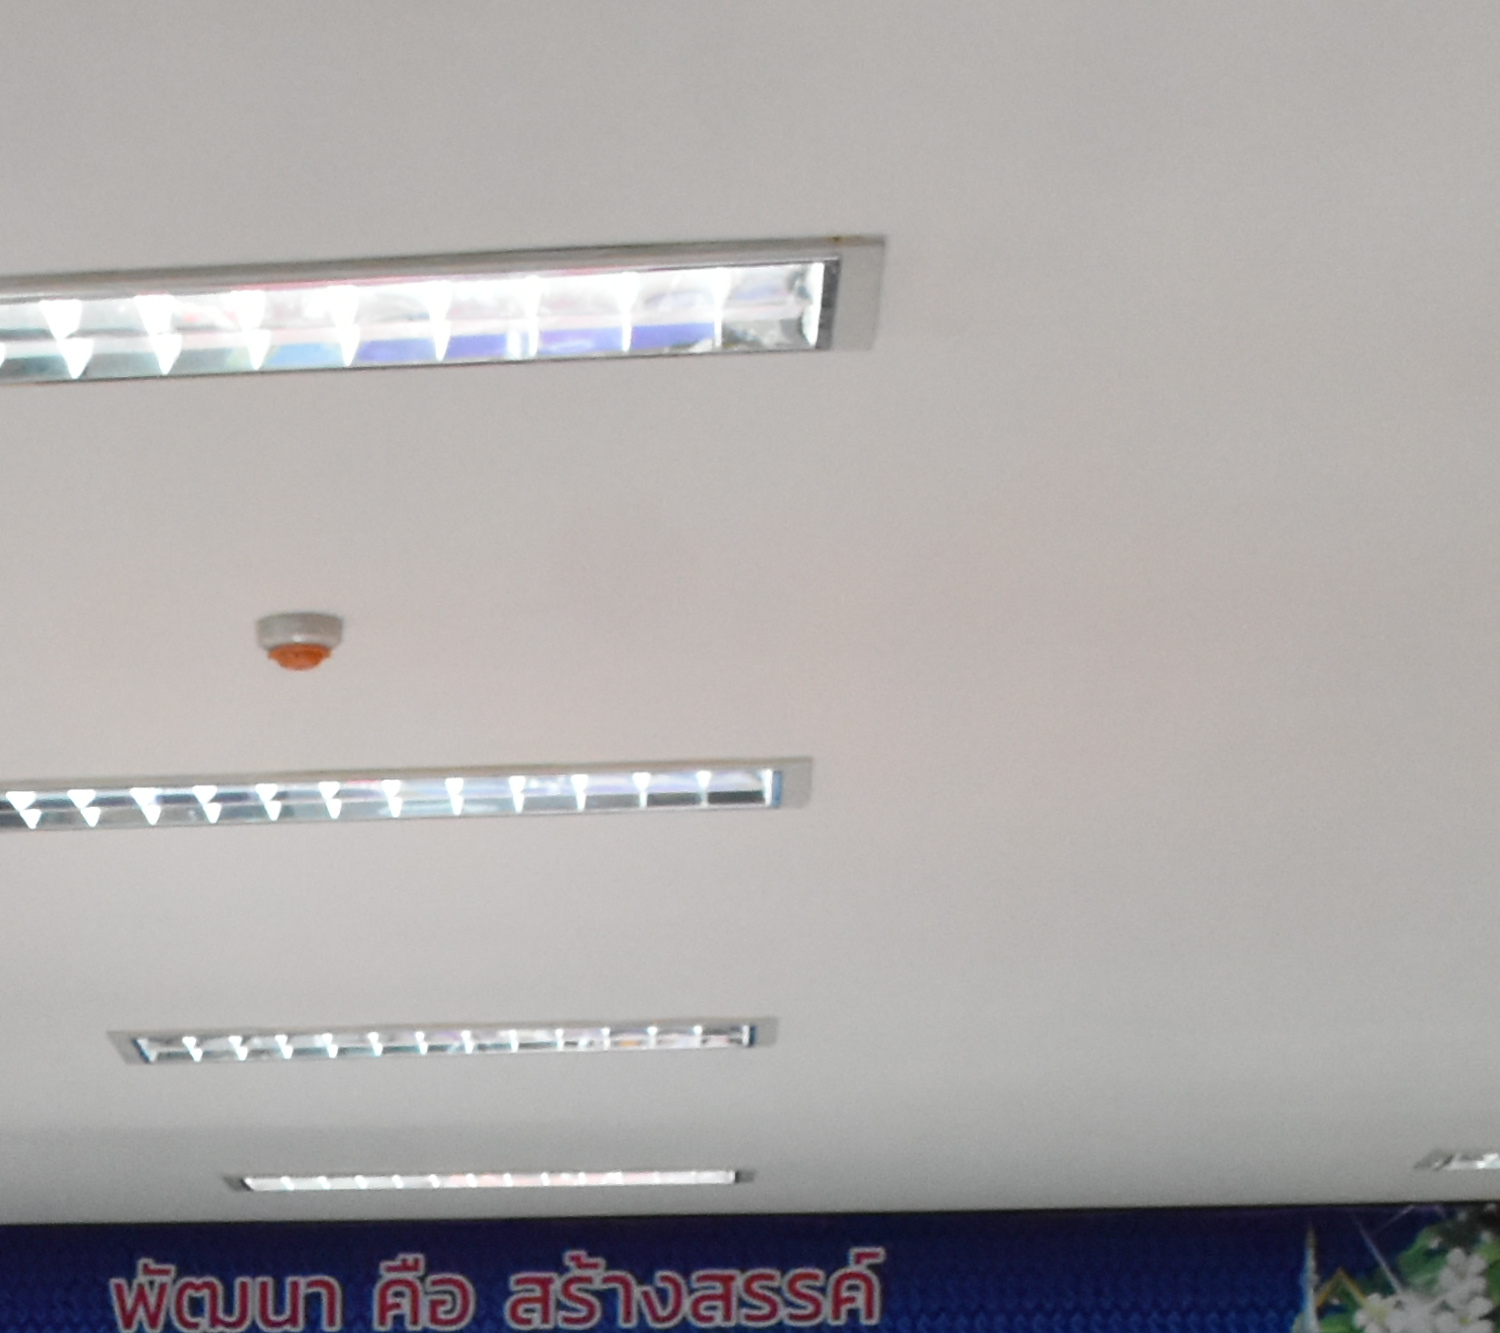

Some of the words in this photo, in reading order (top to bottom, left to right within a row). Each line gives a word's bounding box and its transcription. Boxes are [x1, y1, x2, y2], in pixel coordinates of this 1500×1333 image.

[110, 1258, 342, 1333] พัฒนา
[373, 1253, 476, 1332] คือ
[503, 1246, 886, 1330] สร้างสรรค์
